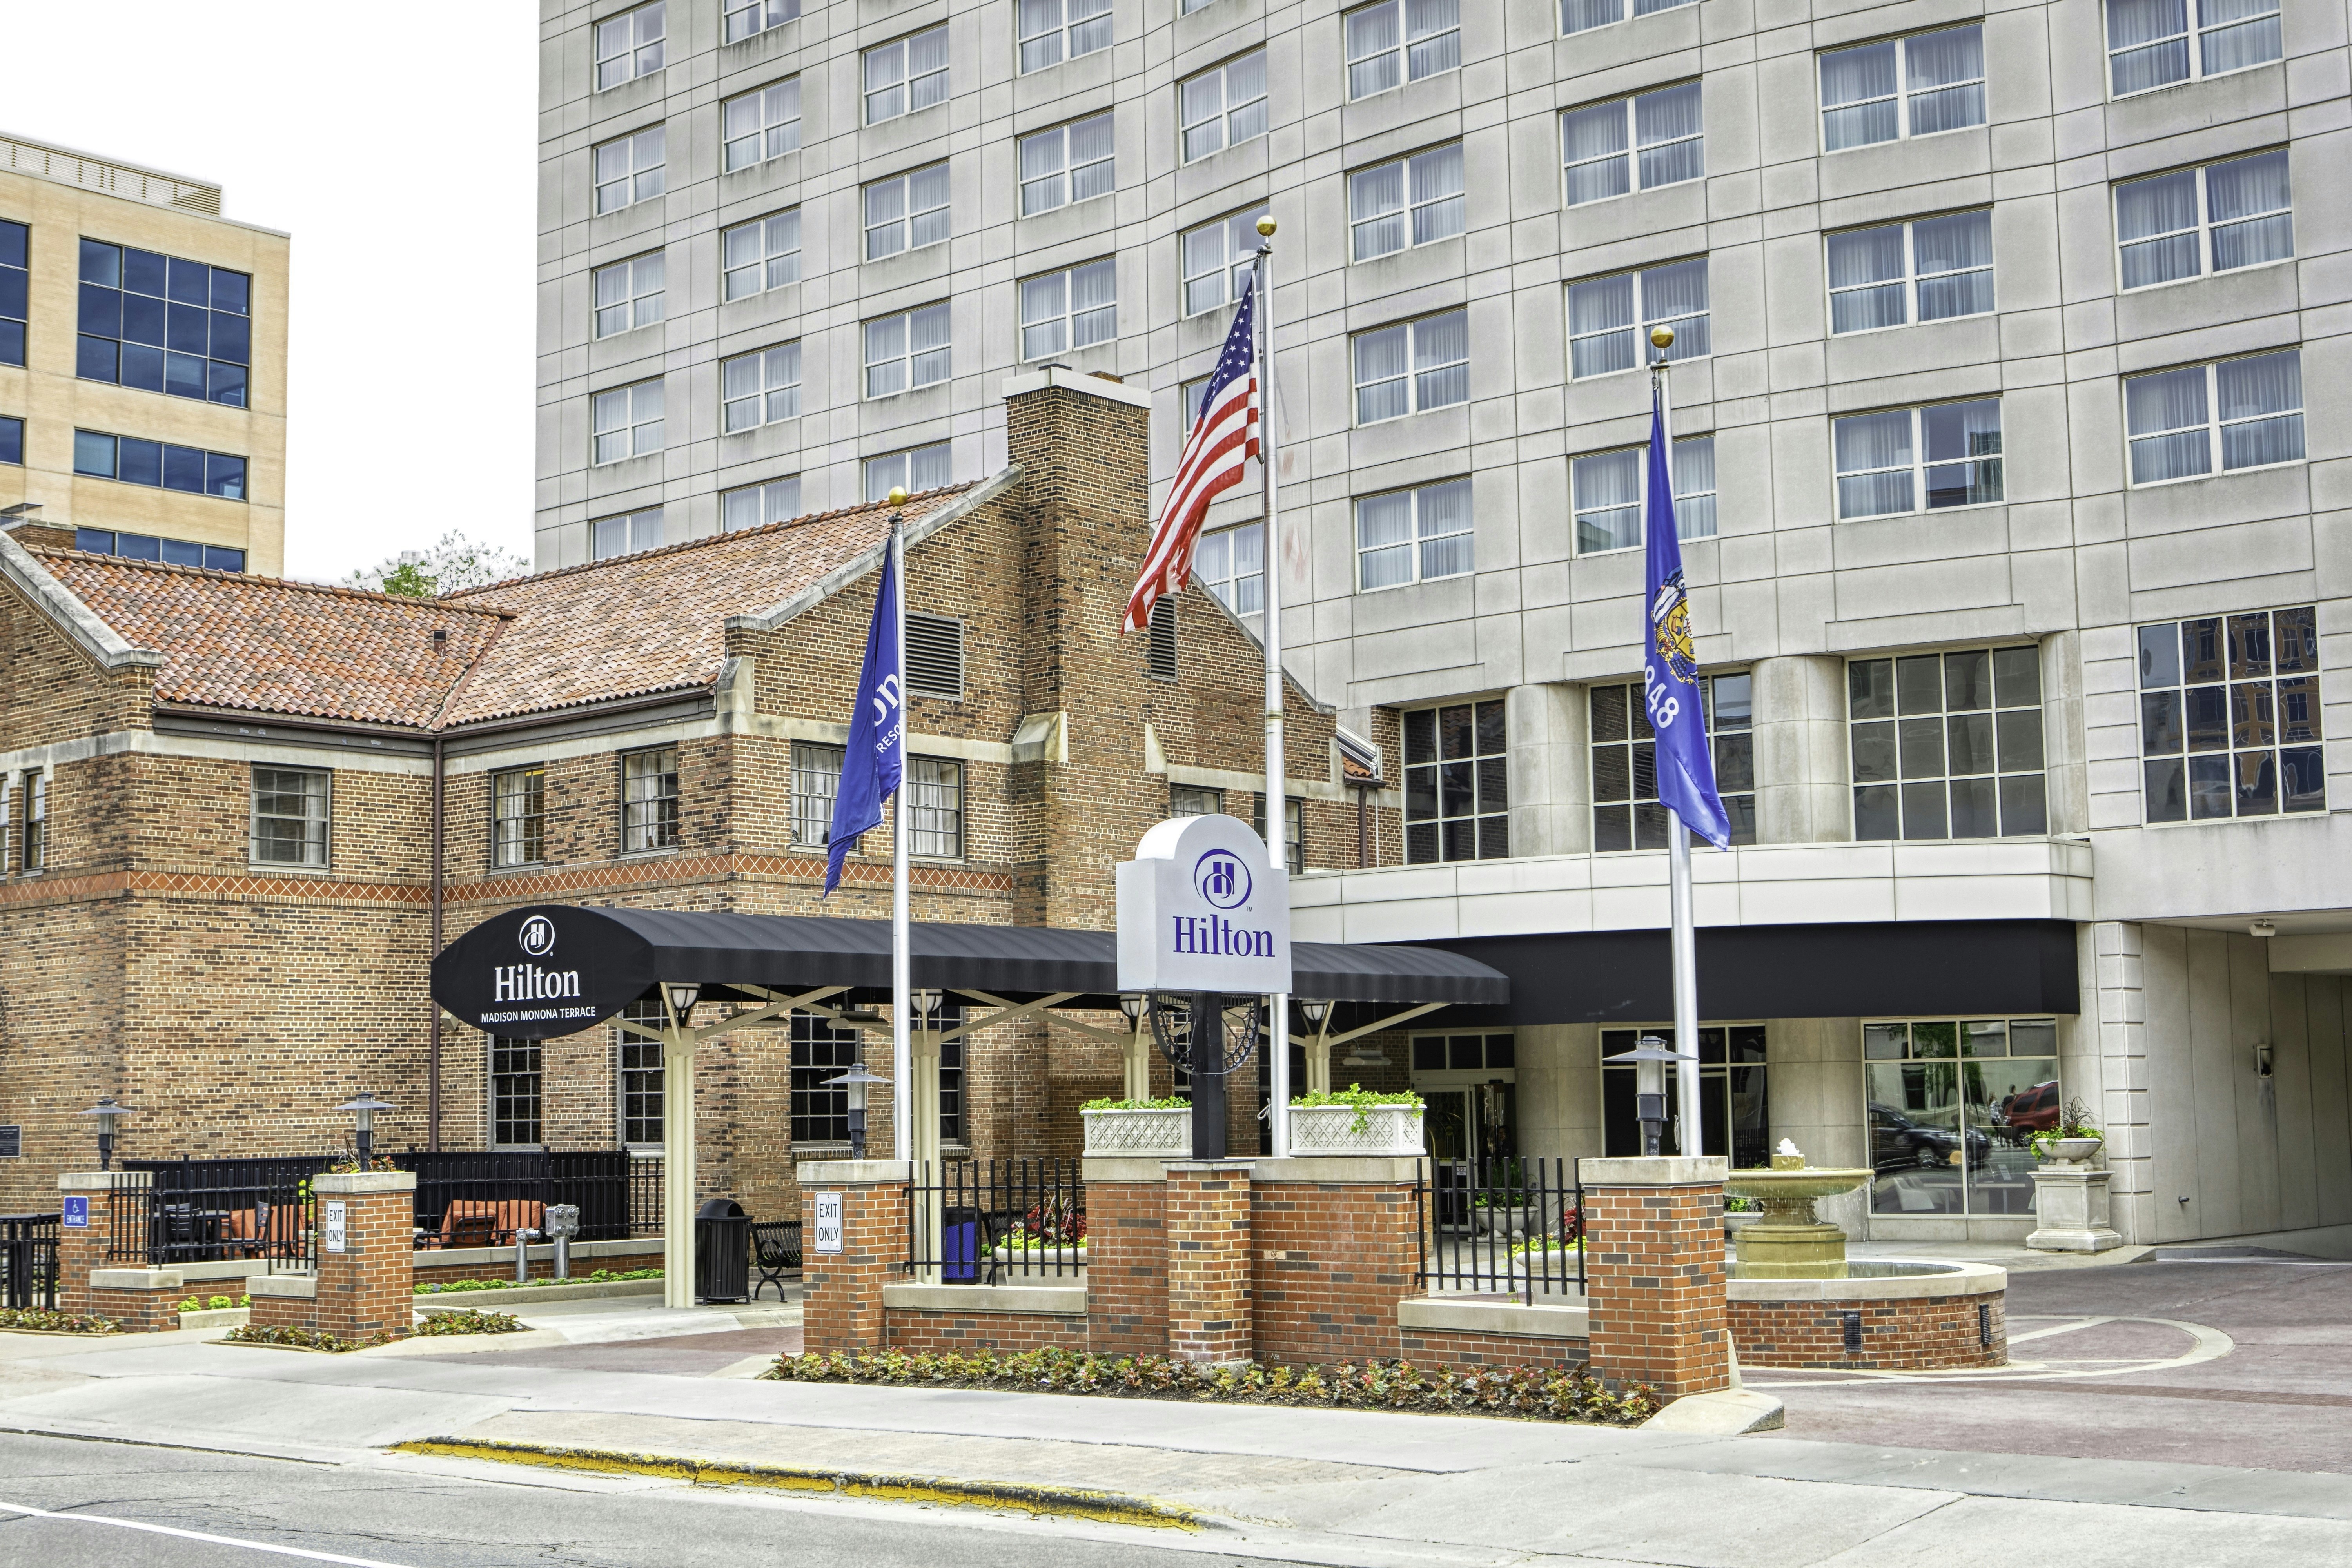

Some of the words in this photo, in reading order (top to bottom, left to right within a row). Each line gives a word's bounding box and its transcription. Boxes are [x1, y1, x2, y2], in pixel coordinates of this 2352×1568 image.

[1645, 656, 1679, 728] 848
[876, 720, 900, 753] RESO
[1172, 914, 1275, 957] Hilton
[495, 964, 580, 1002] Hilton
[481, 1011, 518, 1023] MADISON
[521, 1009, 558, 1021] MONONA
[559, 1006, 595, 1018] TERRACE
[330, 1210, 342, 1222] EXIT
[820, 1203, 837, 1218] EXIT
[329, 1230, 343, 1242] ONLY
[819, 1227, 838, 1241] ONLY
